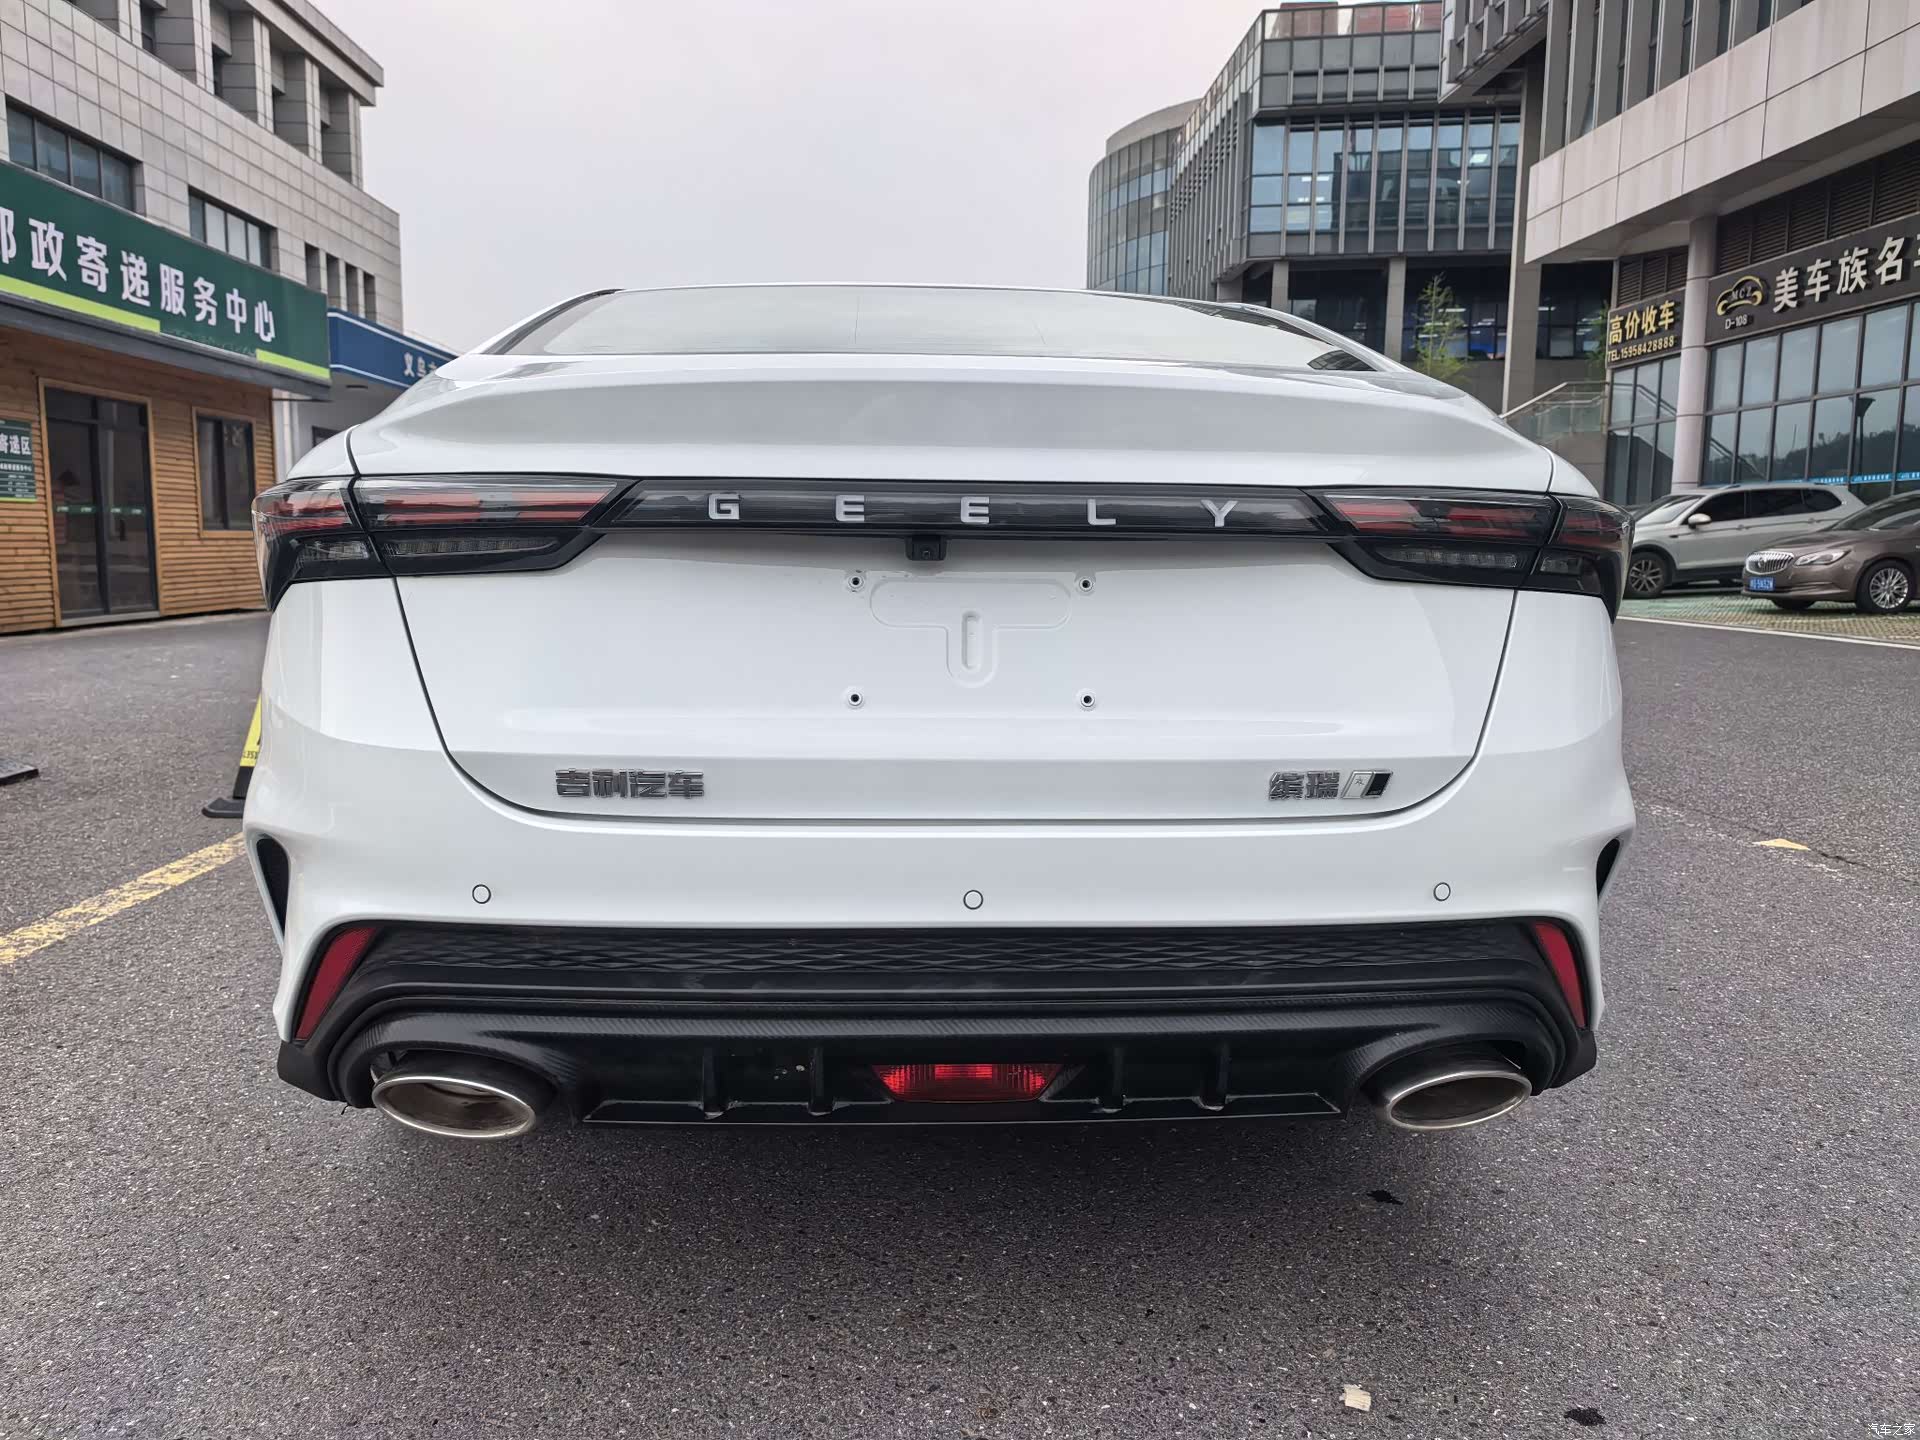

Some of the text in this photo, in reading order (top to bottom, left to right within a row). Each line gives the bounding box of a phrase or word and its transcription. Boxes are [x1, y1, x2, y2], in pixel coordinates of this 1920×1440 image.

[1609, 300, 1675, 345] 高价收车
[1725, 314, 1748, 330] D-108
[708, 492, 1238, 528] GEELY
[555, 767, 705, 799] 吉利汽车
[1269, 770, 1340, 800] 缤瑞
